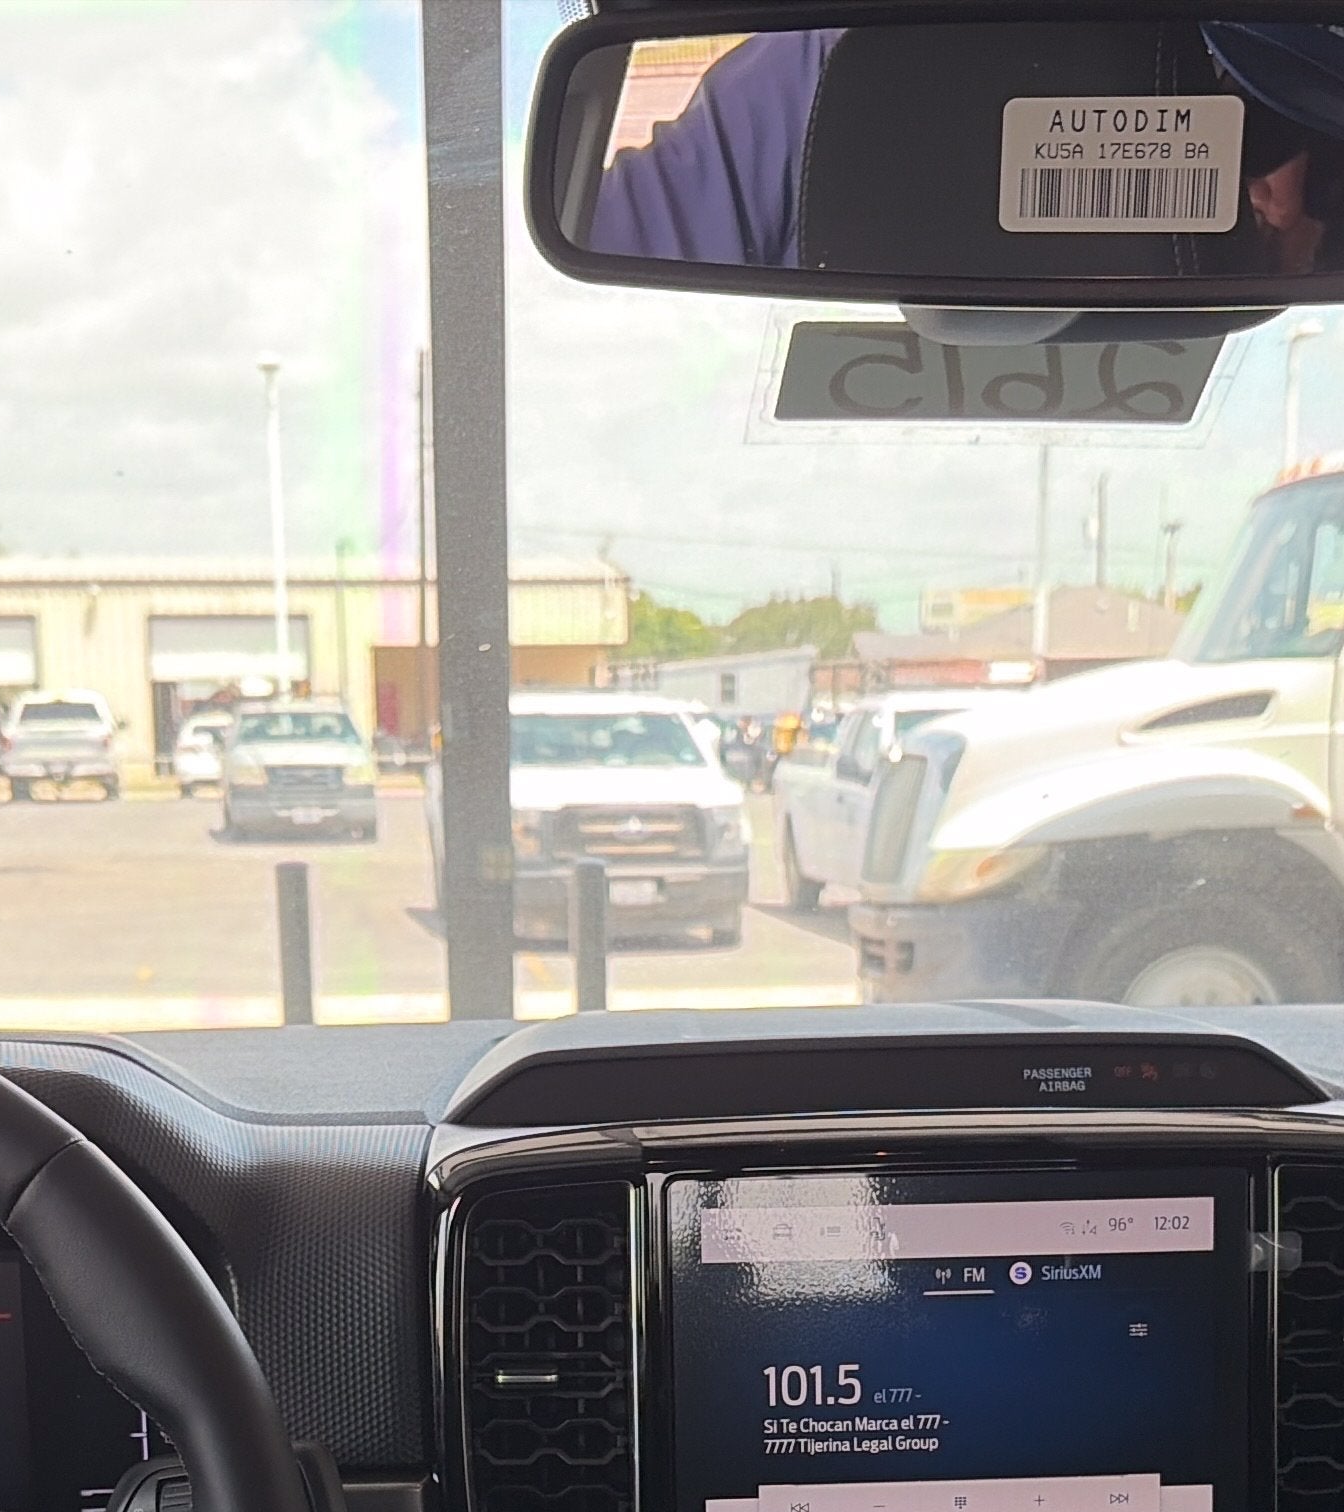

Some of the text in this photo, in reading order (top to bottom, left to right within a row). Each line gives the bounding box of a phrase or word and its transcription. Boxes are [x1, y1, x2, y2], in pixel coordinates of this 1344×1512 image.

[1049, 109, 1192, 132] AUTODIM
[1099, 142, 1172, 159] 17E678
[1185, 142, 1210, 159] BA
[1023, 1067, 1093, 1080] PASSENGER
[1039, 1081, 1086, 1092] AIRBAG
[1154, 1215, 1190, 1231] 12:02
[963, 1268, 985, 1283] FM
[1041, 1264, 1102, 1281] SiriusXM
[763, 1364, 862, 1408] 101.5
[873, 1389, 887, 1404] el
[889, 1388, 913, 1403] 777
[764, 1418, 778, 1434] Si
[780, 1418, 798, 1433] Te
[800, 1416, 852, 1433] Chocan
[855, 1415, 899, 1432] Marca
[901, 1415, 915, 1430] el
[917, 1414, 941, 1430] 777
[764, 1435, 939, 1455] 7777 Tijerina Legal Group
